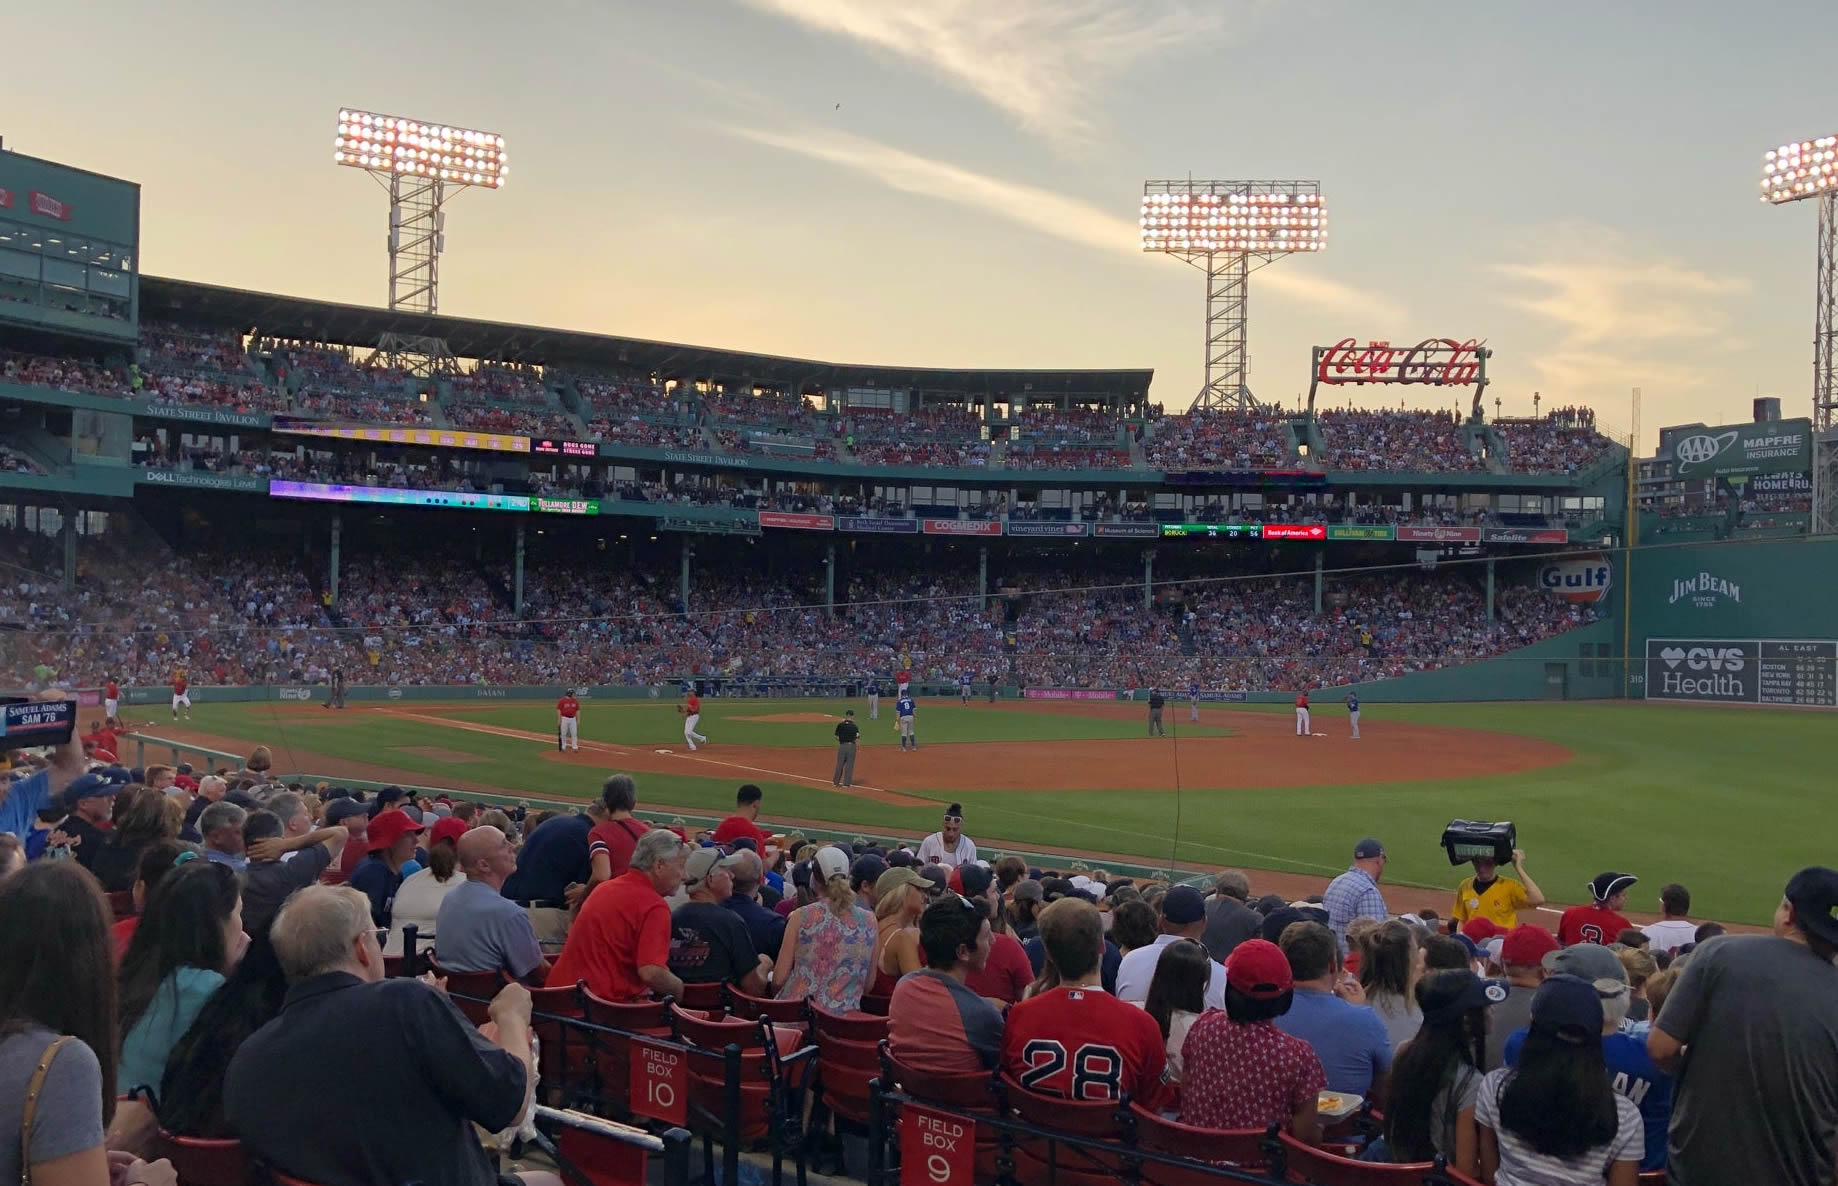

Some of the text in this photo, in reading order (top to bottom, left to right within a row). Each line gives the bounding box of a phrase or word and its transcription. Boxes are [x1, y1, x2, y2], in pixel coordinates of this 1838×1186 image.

[1319, 338, 1487, 385] Coca-Cola
[147, 405, 259, 425] STATE STREET PAVILION
[1680, 437, 1714, 461] AAA
[1743, 435, 1803, 449] MAPFRE
[664, 452, 748, 466] STATE STREET PAVILION
[1746, 448, 1799, 460] INSURANCE
[147, 471, 257, 488] DELL Technologies Level
[1754, 480, 1788, 490] HOME
[572, 501, 588, 509] DEW
[934, 521, 992, 532] COGMEDIX
[1012, 525, 1044, 534] vineyard
[1490, 533, 1528, 541] Safelite
[1542, 567, 1608, 587] Gulf
[1668, 572, 1740, 604] JIM BEAM
[1687, 648, 1744, 671] CVS
[1630, 674, 1644, 684] 310
[1662, 672, 1744, 696] Health
[9, 704, 67, 717] SAMUEL ADAMS
[22, 714, 41, 725] SAM
[1580, 924, 1602, 945] 3
[642, 1048, 678, 1066] FIELD
[647, 1062, 673, 1079] BOX
[1020, 1038, 1123, 1100] 28
[648, 1080, 674, 1107] 10
[1612, 1072, 1650, 1106] AN
[918, 1116, 964, 1138] FIELD
[923, 1132, 956, 1152] BOX
[927, 1154, 951, 1182] 9
